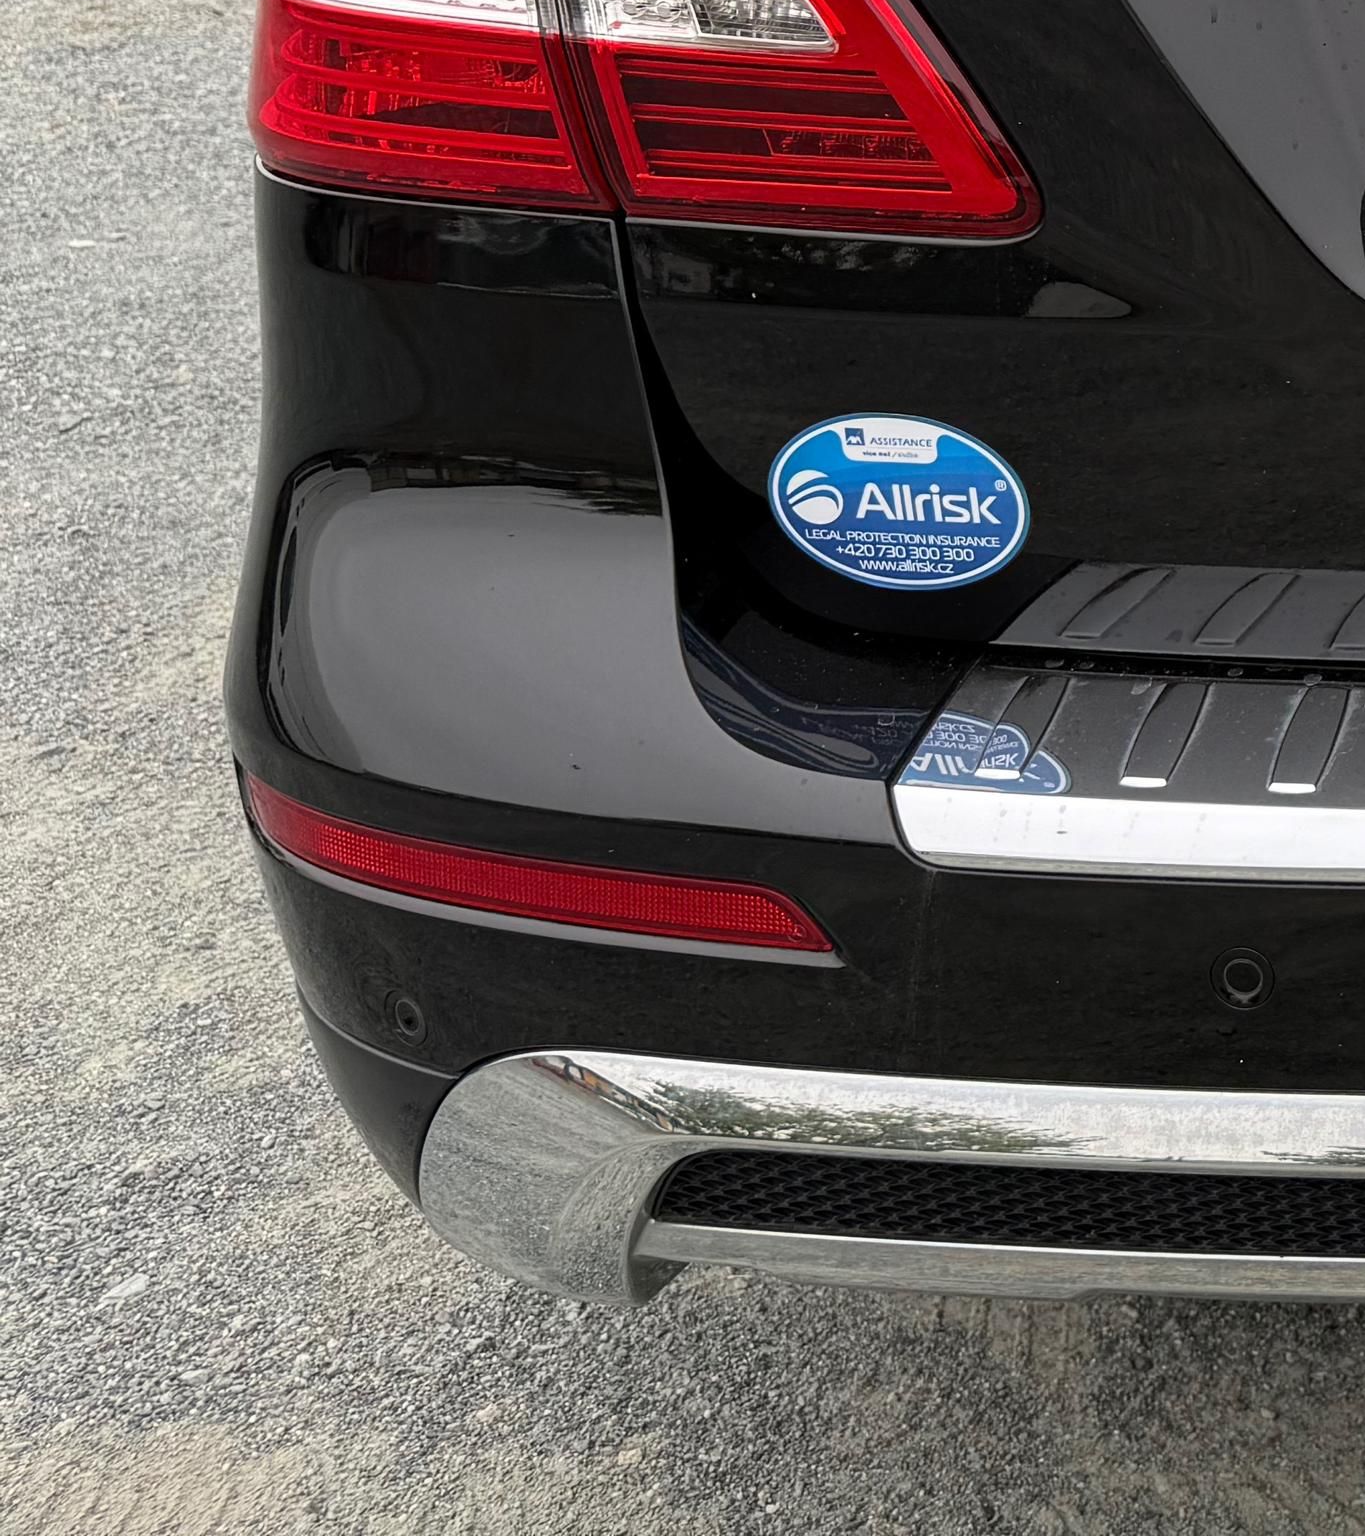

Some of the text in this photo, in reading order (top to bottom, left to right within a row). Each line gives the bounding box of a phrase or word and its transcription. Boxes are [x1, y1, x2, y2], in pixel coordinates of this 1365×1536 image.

[869, 437, 933, 448] ASSISTANCE
[855, 482, 1002, 525] Allrisk
[805, 528, 1001, 548] LEGAL PROTECTION INSURANCE
[835, 543, 975, 562] +420 730 300 300
[859, 559, 955, 575] www.allrisk.cz
